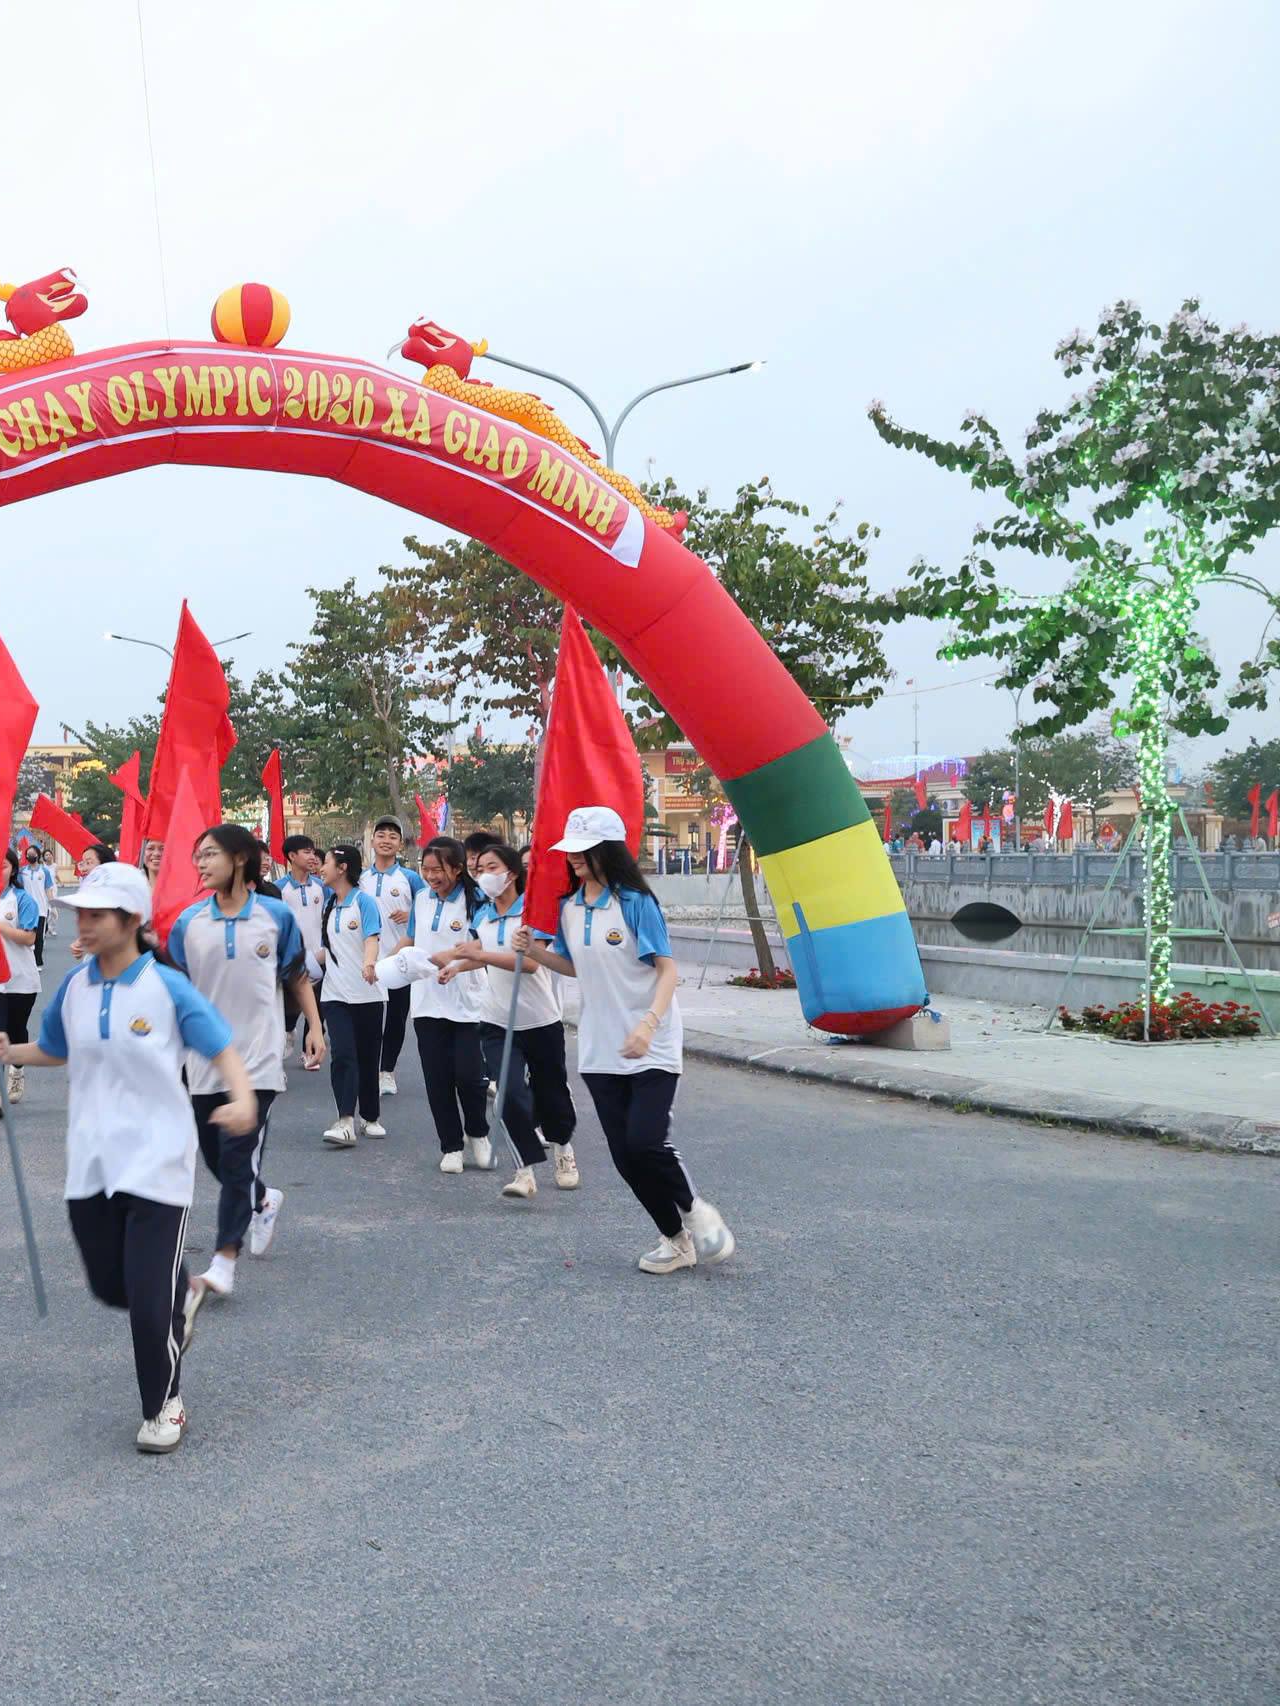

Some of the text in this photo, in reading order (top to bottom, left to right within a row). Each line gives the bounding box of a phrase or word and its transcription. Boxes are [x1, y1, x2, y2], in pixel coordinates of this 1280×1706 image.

[106, 365, 273, 425] OLYMPIC
[282, 366, 376, 430] 2026
[442, 410, 530, 480] GIAO
[526, 448, 619, 536] MINH
